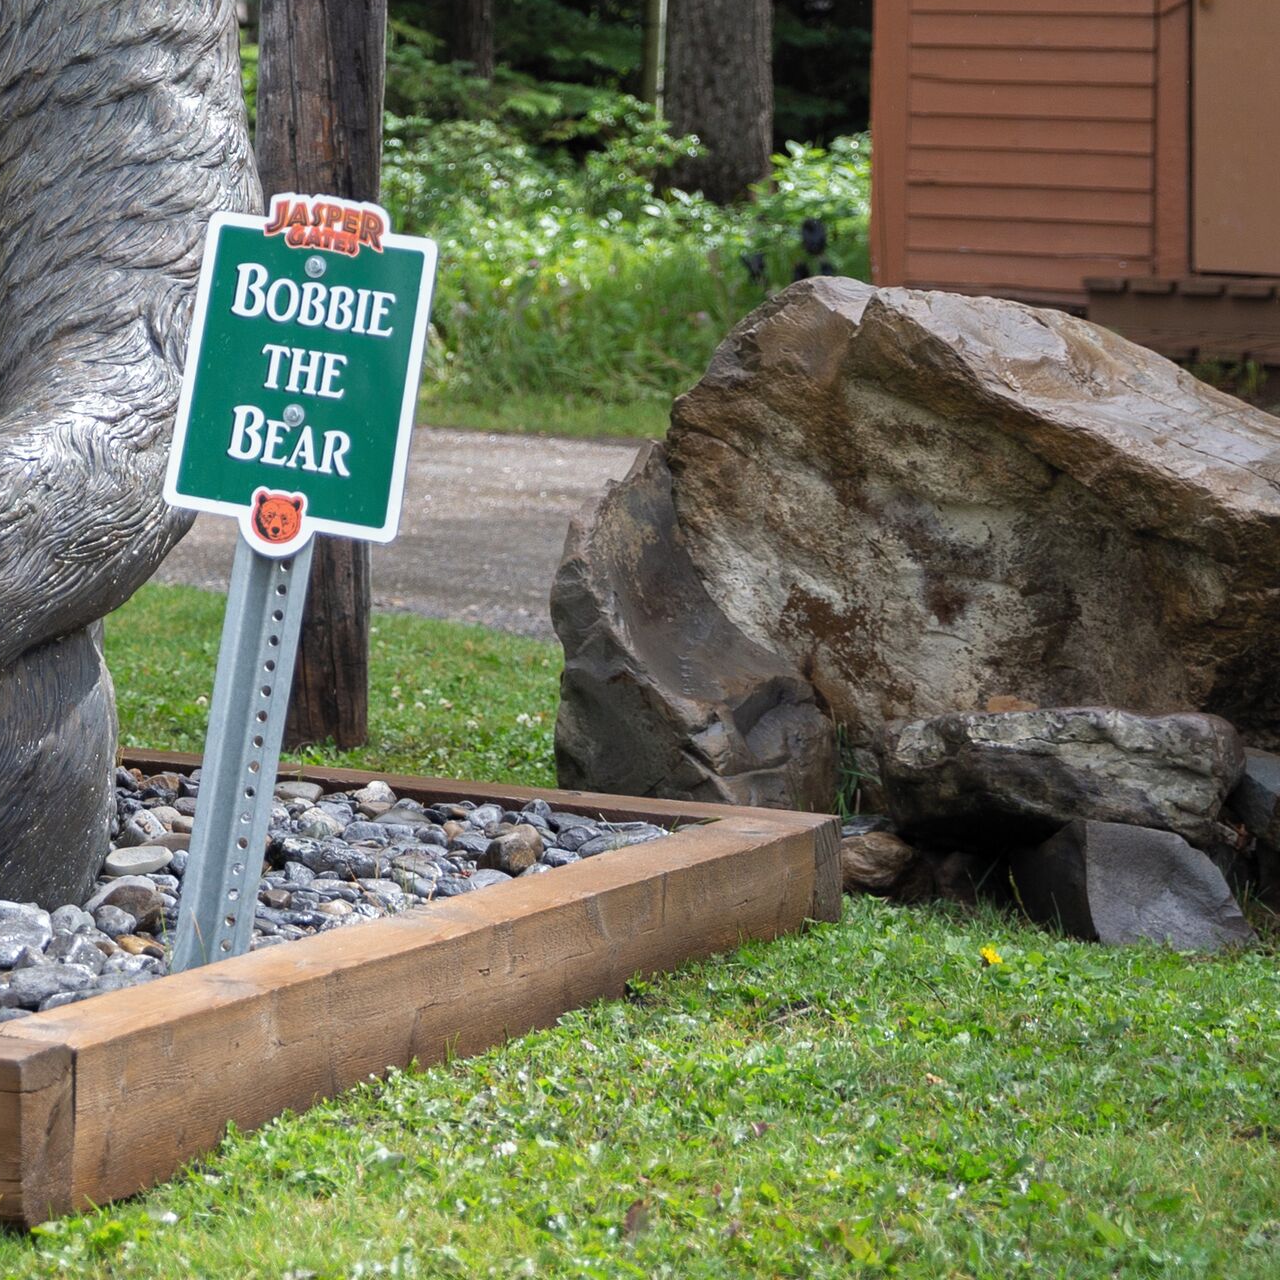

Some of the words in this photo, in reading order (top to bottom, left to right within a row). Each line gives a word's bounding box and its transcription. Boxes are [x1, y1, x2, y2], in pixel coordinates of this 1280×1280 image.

[264, 199, 384, 253] JASPER
[285, 225, 359, 256] GATES
[231, 263, 396, 337] BOBBIE
[262, 343, 348, 398] THE
[227, 405, 350, 477] BEAR
